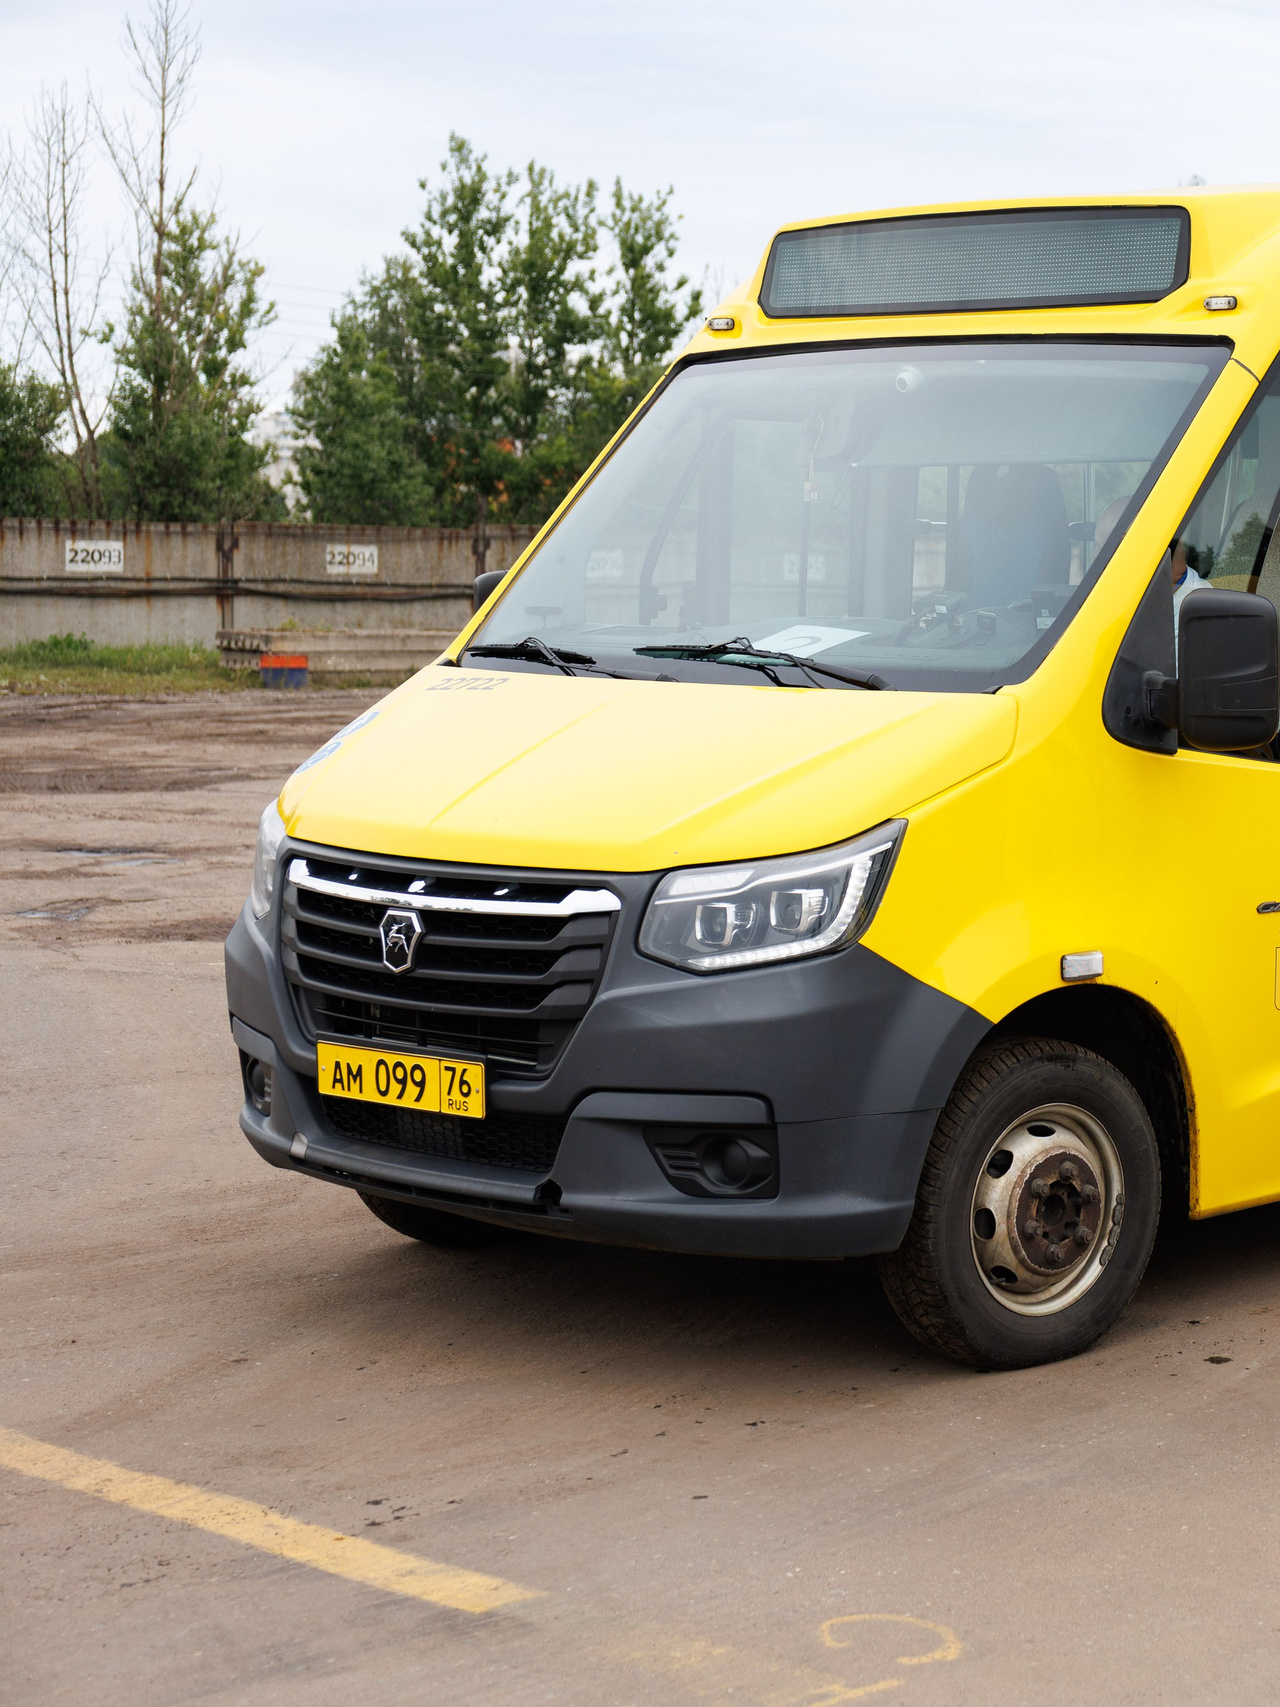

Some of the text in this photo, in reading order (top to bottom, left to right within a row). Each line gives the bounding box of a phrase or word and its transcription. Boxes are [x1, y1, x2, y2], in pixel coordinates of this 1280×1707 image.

[68, 548, 122, 565] 22093
[326, 550, 375, 567] 22094
[425, 677, 509, 691] 22722
[331, 1058, 472, 1103] АМ 099 76
[447, 1098, 469, 1112] RUS
